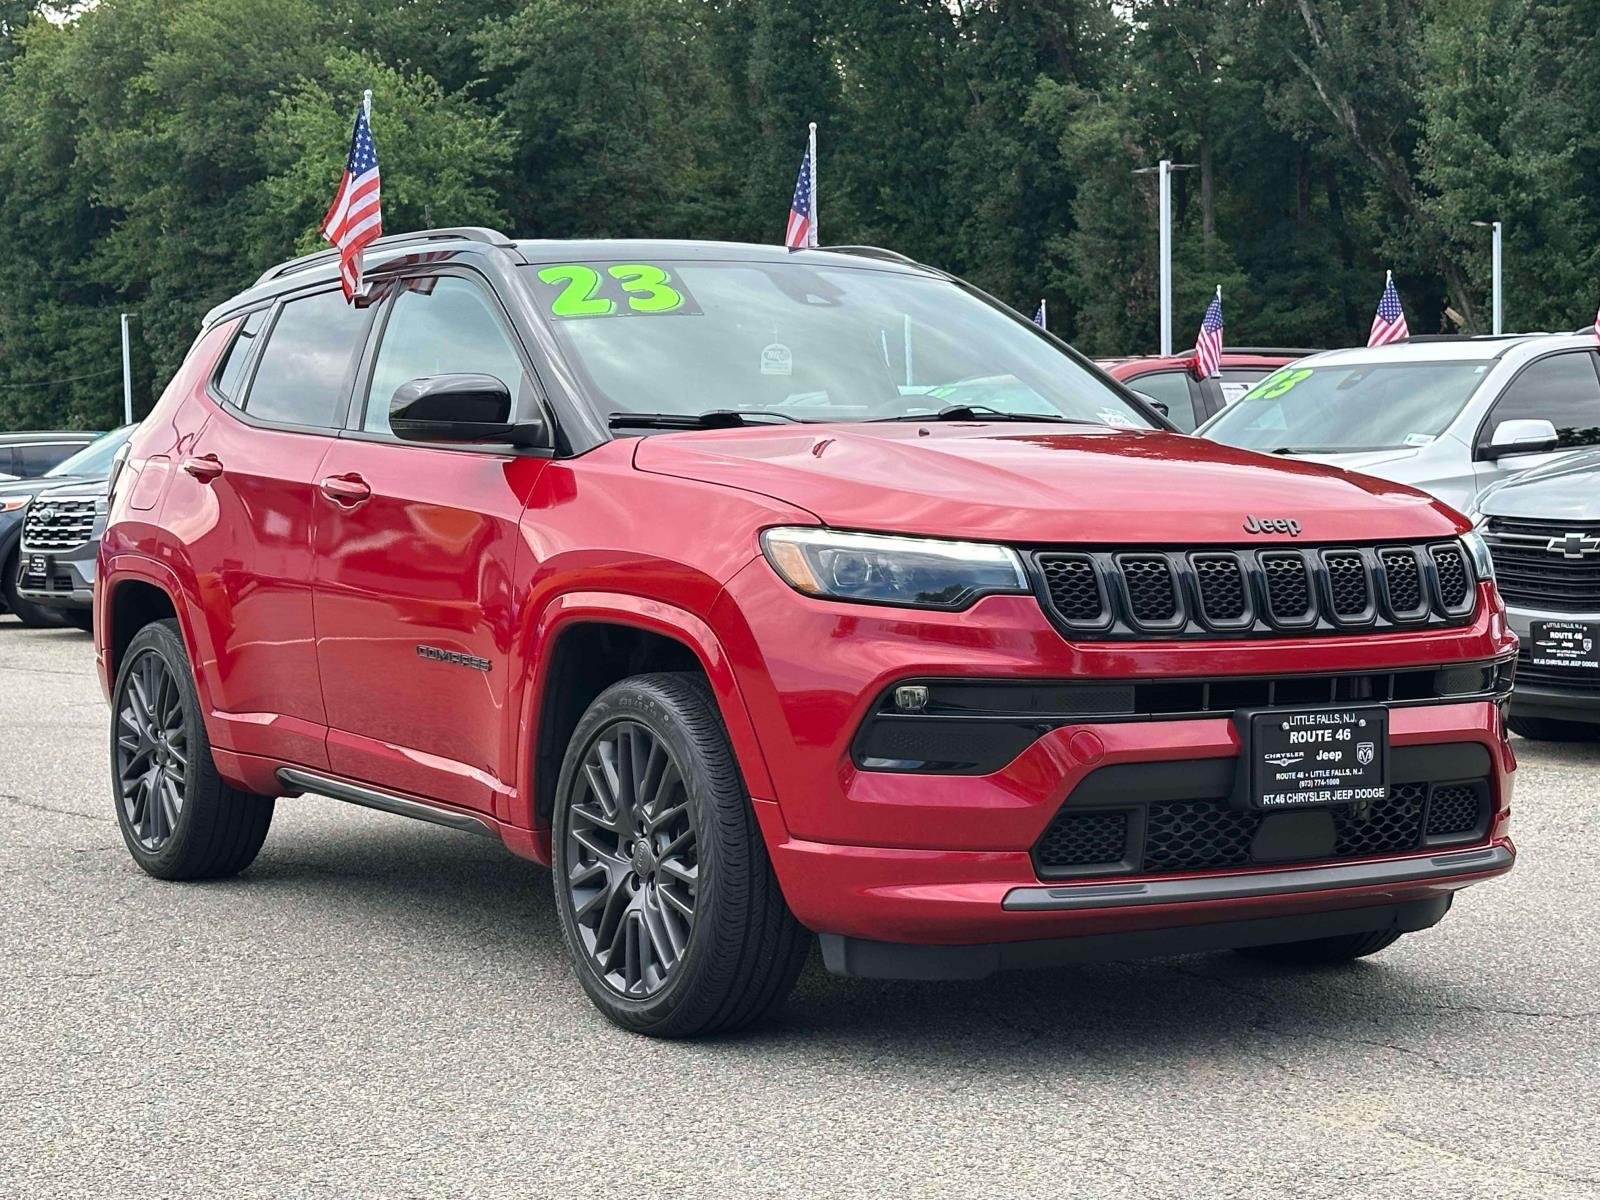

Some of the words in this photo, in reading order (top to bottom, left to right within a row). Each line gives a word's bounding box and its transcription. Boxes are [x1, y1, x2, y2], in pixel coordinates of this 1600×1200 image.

[537, 264, 686, 316] 23
[1243, 514, 1302, 537] Jeep
[416, 644, 493, 672] COMPASS
[1290, 715, 1315, 726] LITTLE
[1316, 713, 1342, 725] FALLS,
[1289, 729, 1332, 743] ROUTE
[1335, 728, 1351, 741] 46
[1264, 751, 1304, 759] CHRYSLER
[1316, 749, 1342, 762] Jeep
[1275, 772, 1296, 780] ROUTE
[1310, 769, 1330, 778] LITTLE
[1331, 768, 1351, 776] FALLS,
[1263, 794, 1286, 805] RT.46
[1286, 790, 1331, 804] CHRYSLER
[1332, 789, 1354, 801] JEEP
[1354, 787, 1385, 799] DODGE
